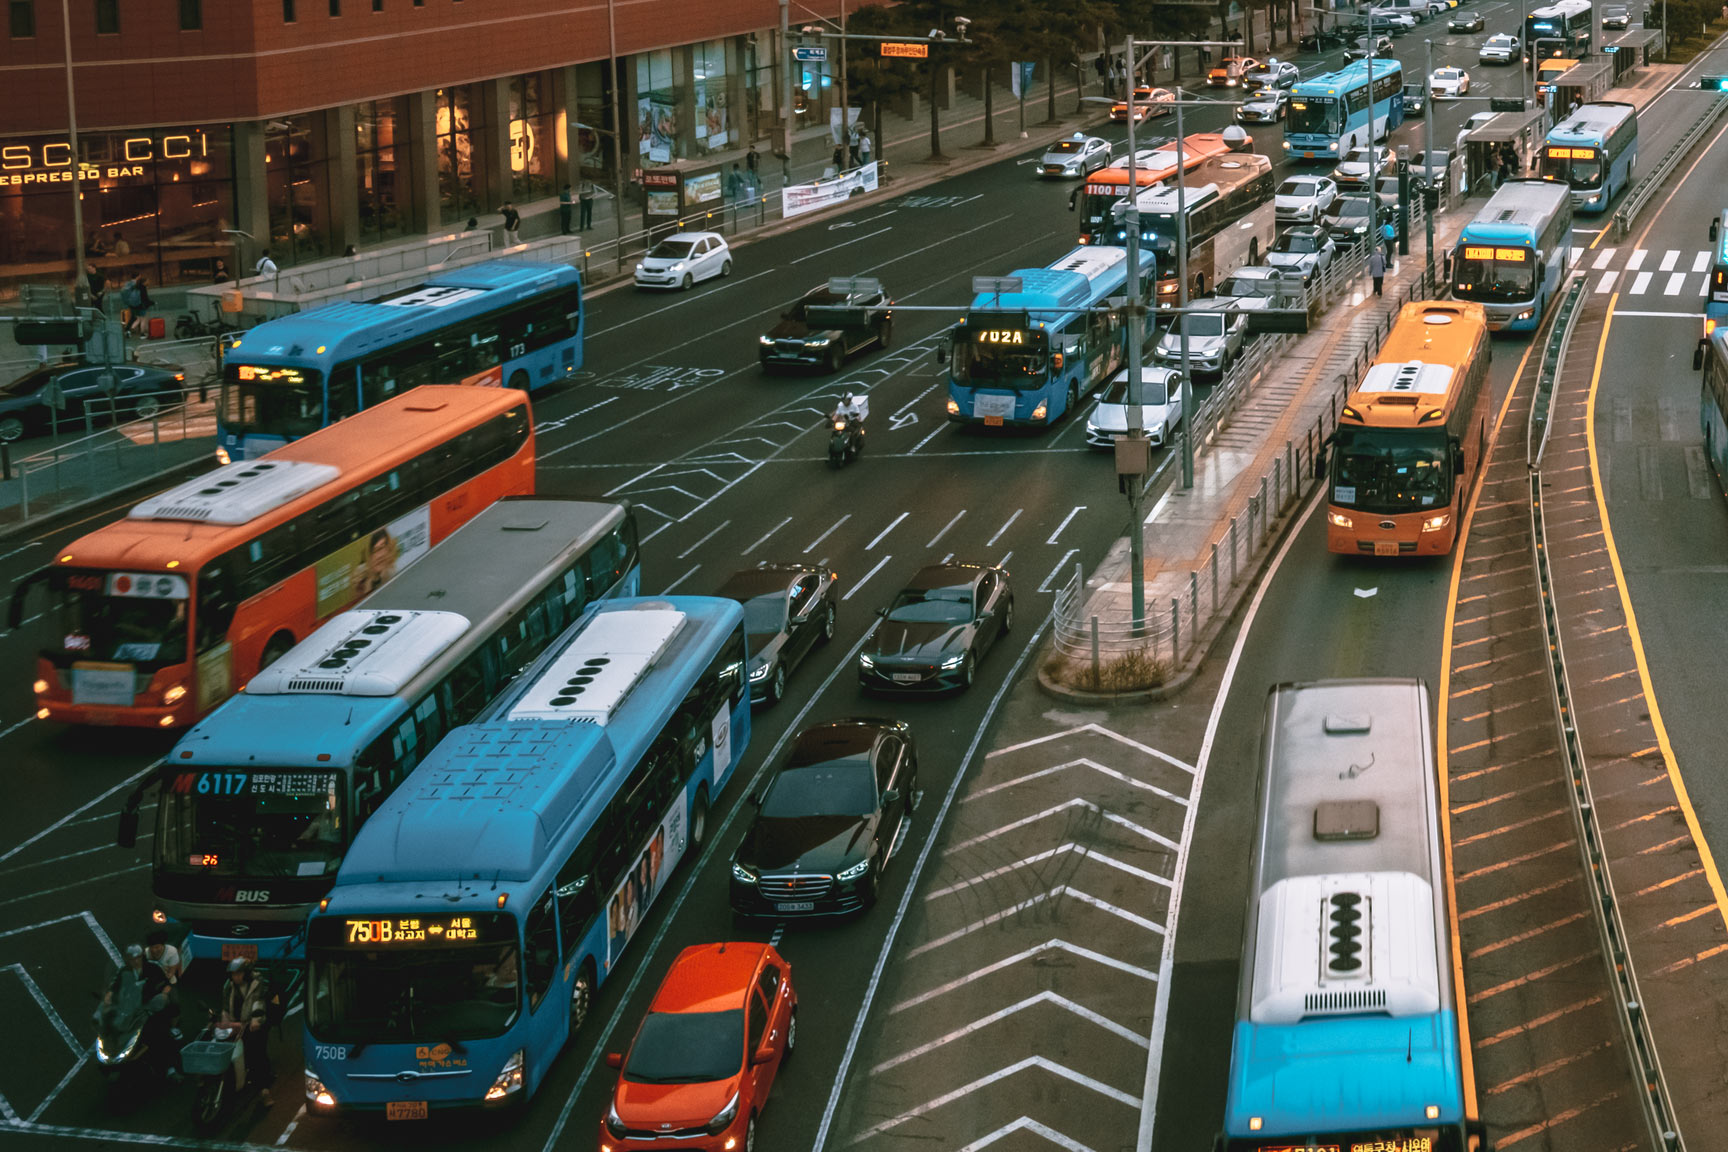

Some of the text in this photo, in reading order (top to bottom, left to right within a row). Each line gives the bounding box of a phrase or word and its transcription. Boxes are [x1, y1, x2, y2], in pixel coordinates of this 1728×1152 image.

[107, 166, 144, 179] BAR
[1400, 162, 1406, 171] 7
[1087, 184, 1112, 195] 1100
[510, 344, 525, 358] 173
[451, 918, 471, 929] 서울
[346, 920, 393, 943] 750B
[394, 929, 477, 941] 차고지 대학교
[315, 1046, 346, 1060] 750B
